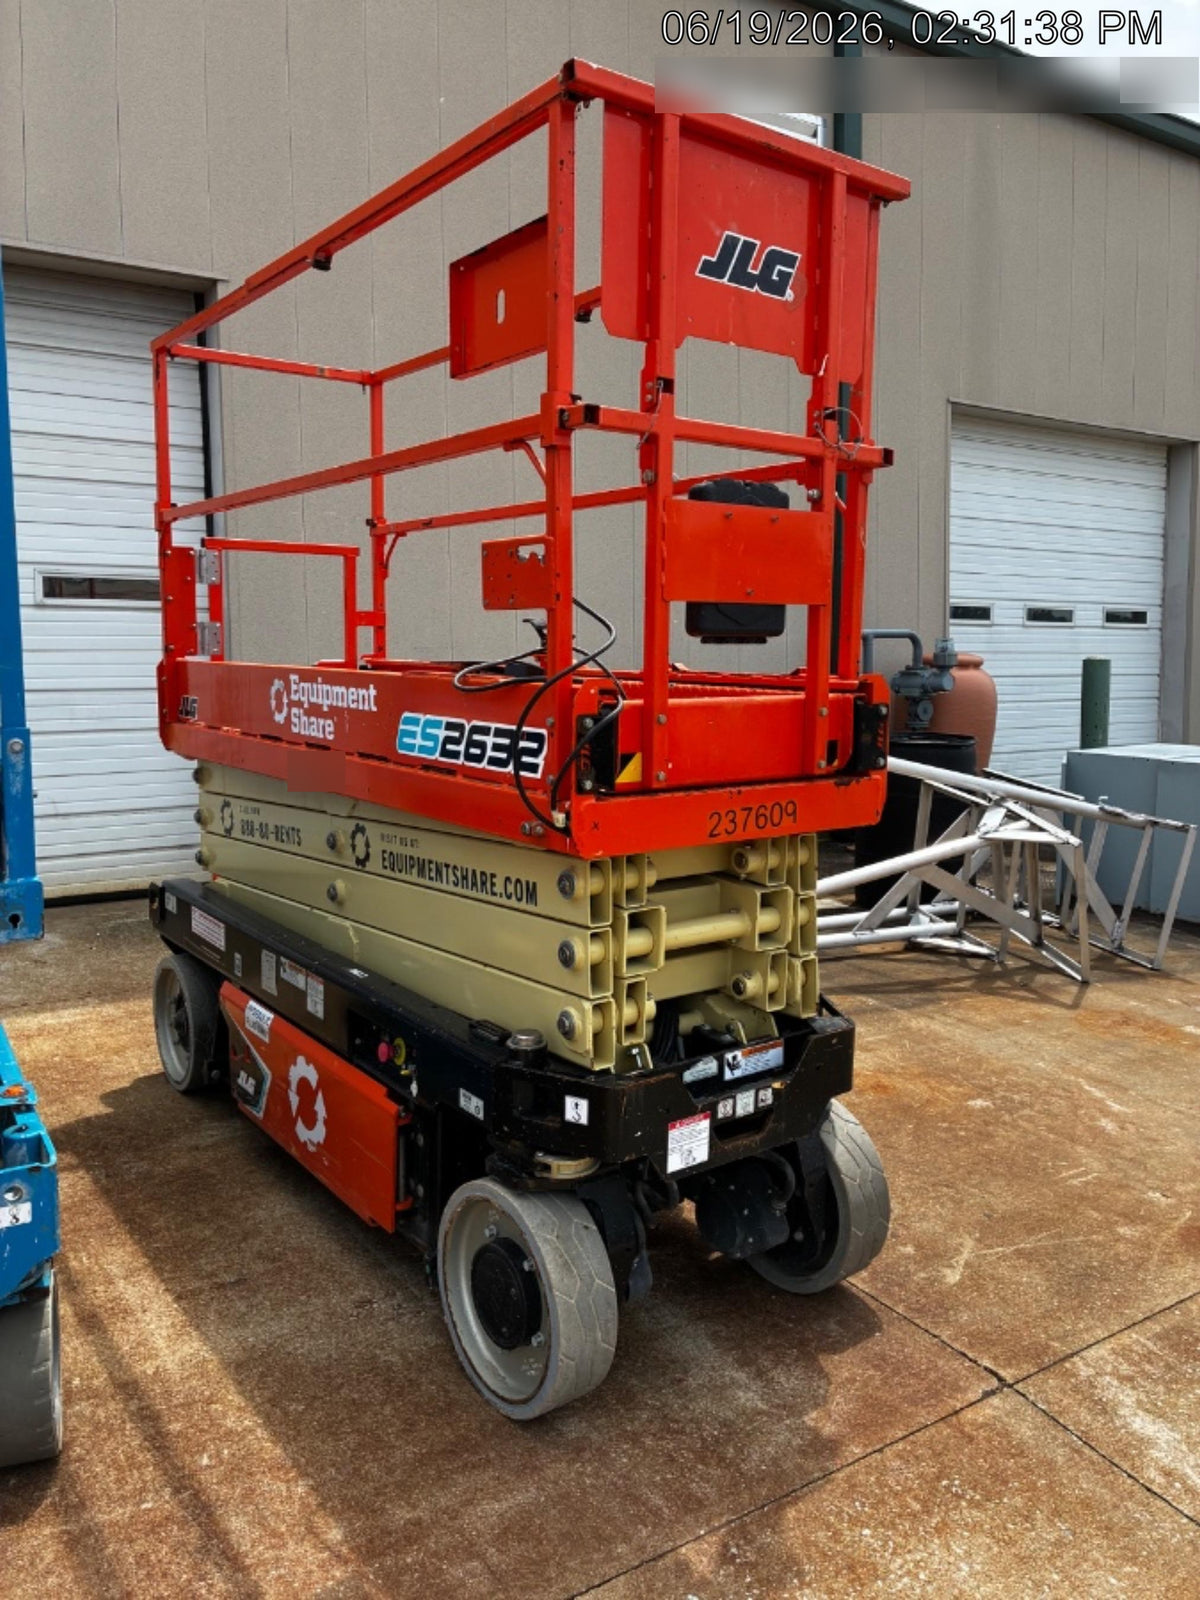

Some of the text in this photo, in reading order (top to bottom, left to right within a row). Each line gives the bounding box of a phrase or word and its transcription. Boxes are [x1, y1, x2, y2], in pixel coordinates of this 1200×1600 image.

[695, 231, 802, 301] JLG
[289, 674, 377, 711] Equipment
[290, 707, 335, 740] Share
[396, 711, 548, 779] ES2632
[707, 800, 798, 838] 237609
[381, 849, 538, 907] EQUIPMENTSHARE.COM
